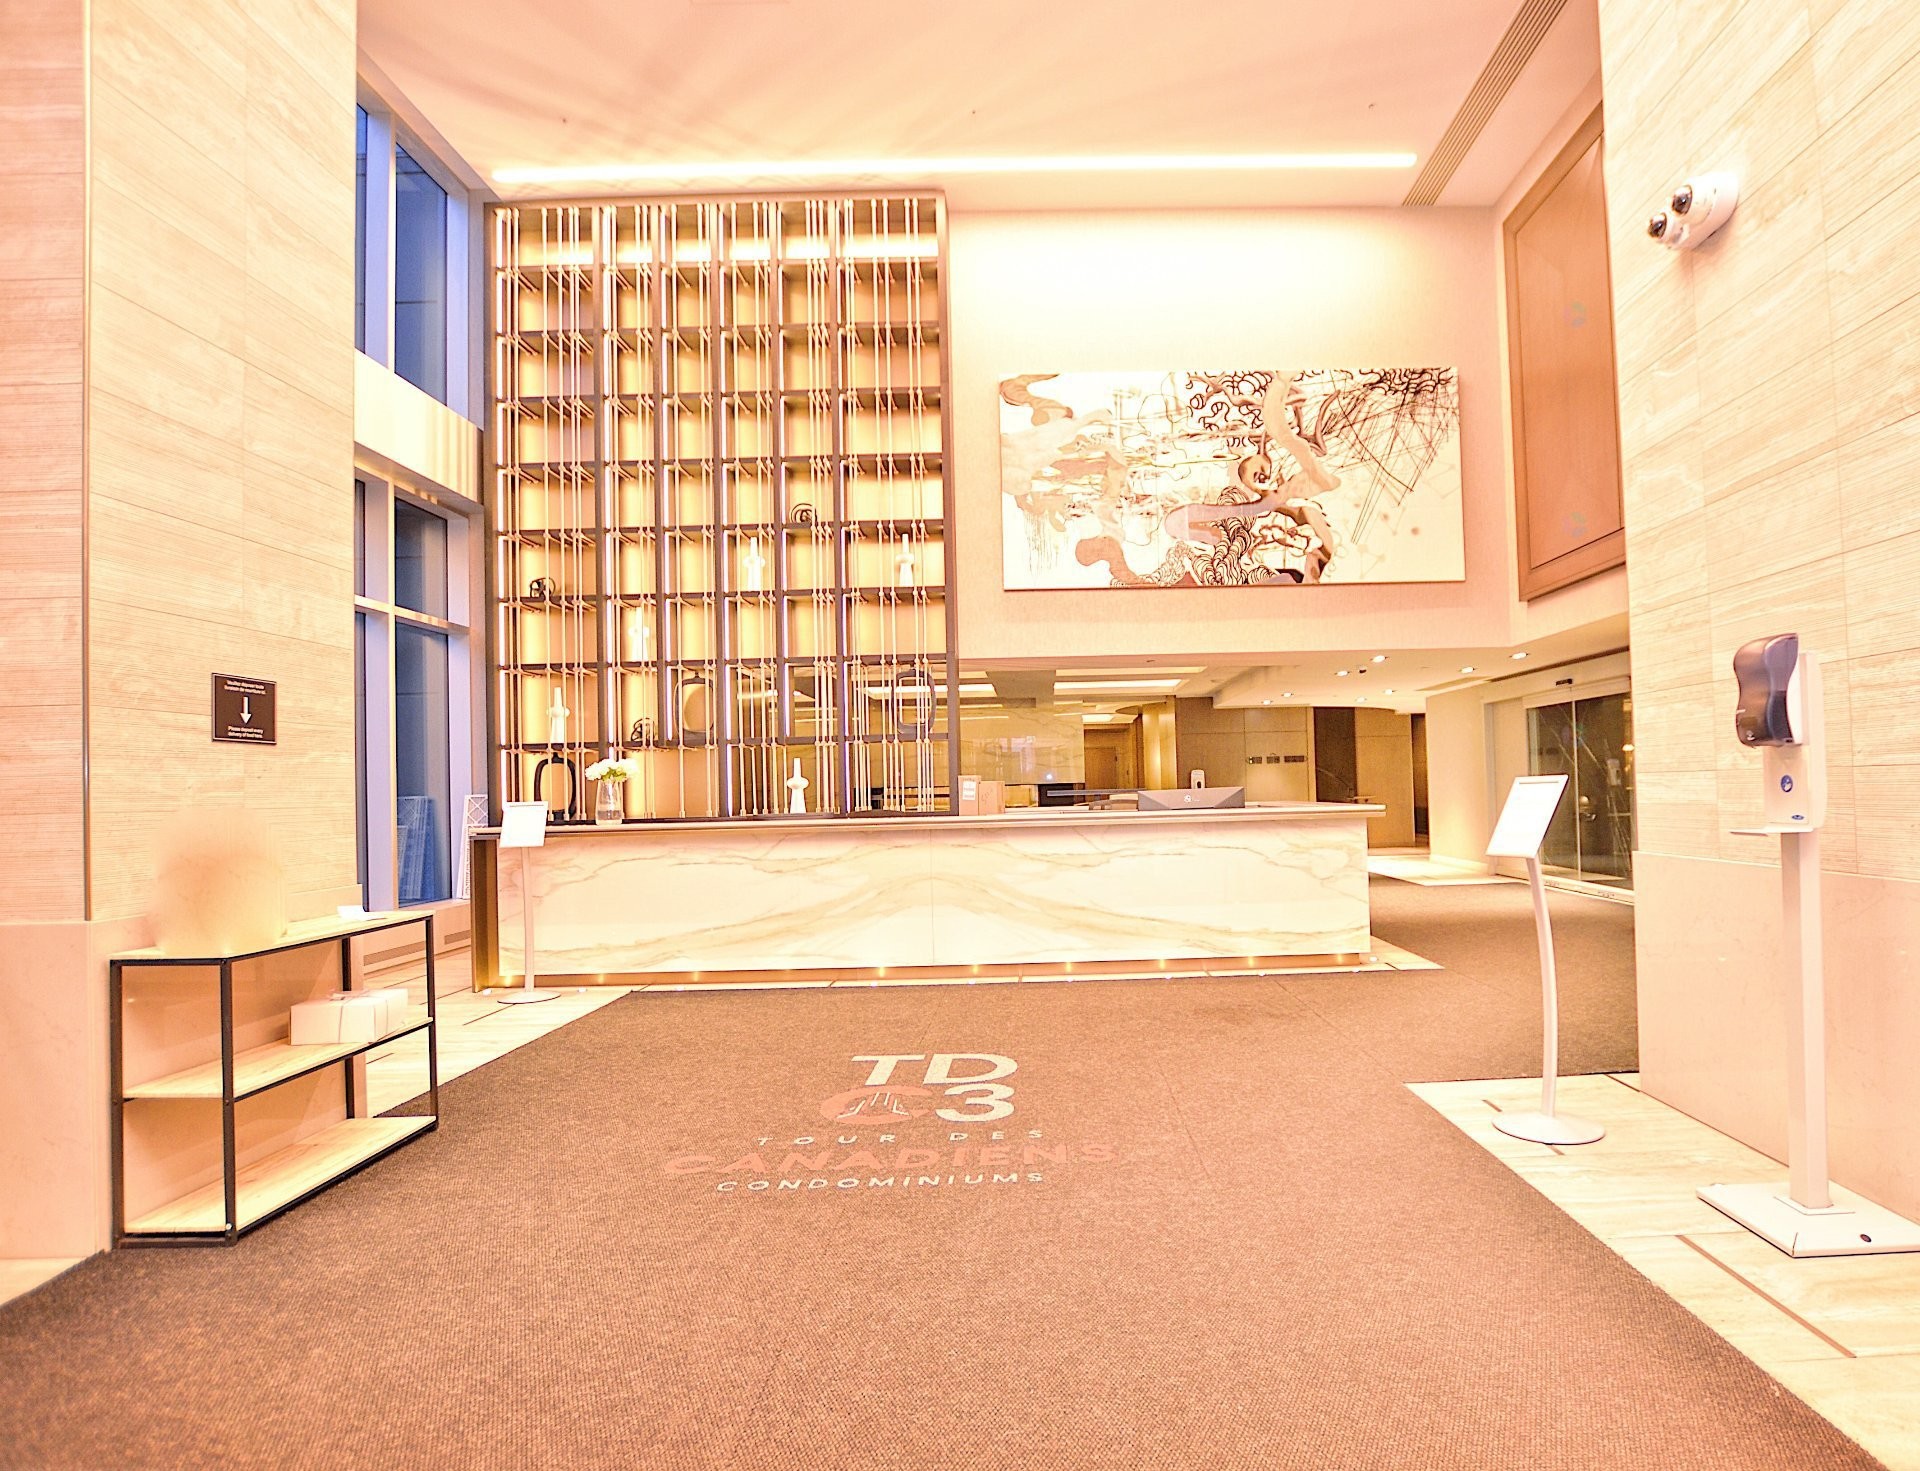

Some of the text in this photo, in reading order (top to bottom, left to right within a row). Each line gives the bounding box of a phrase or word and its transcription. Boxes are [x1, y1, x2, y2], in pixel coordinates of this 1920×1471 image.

[851, 1053, 1018, 1086] TD
[755, 1130, 1043, 1146] TOUR DES
[665, 1143, 1117, 1174] CANADIENS
[716, 1172, 1044, 1191] CONDOMINIUMS
